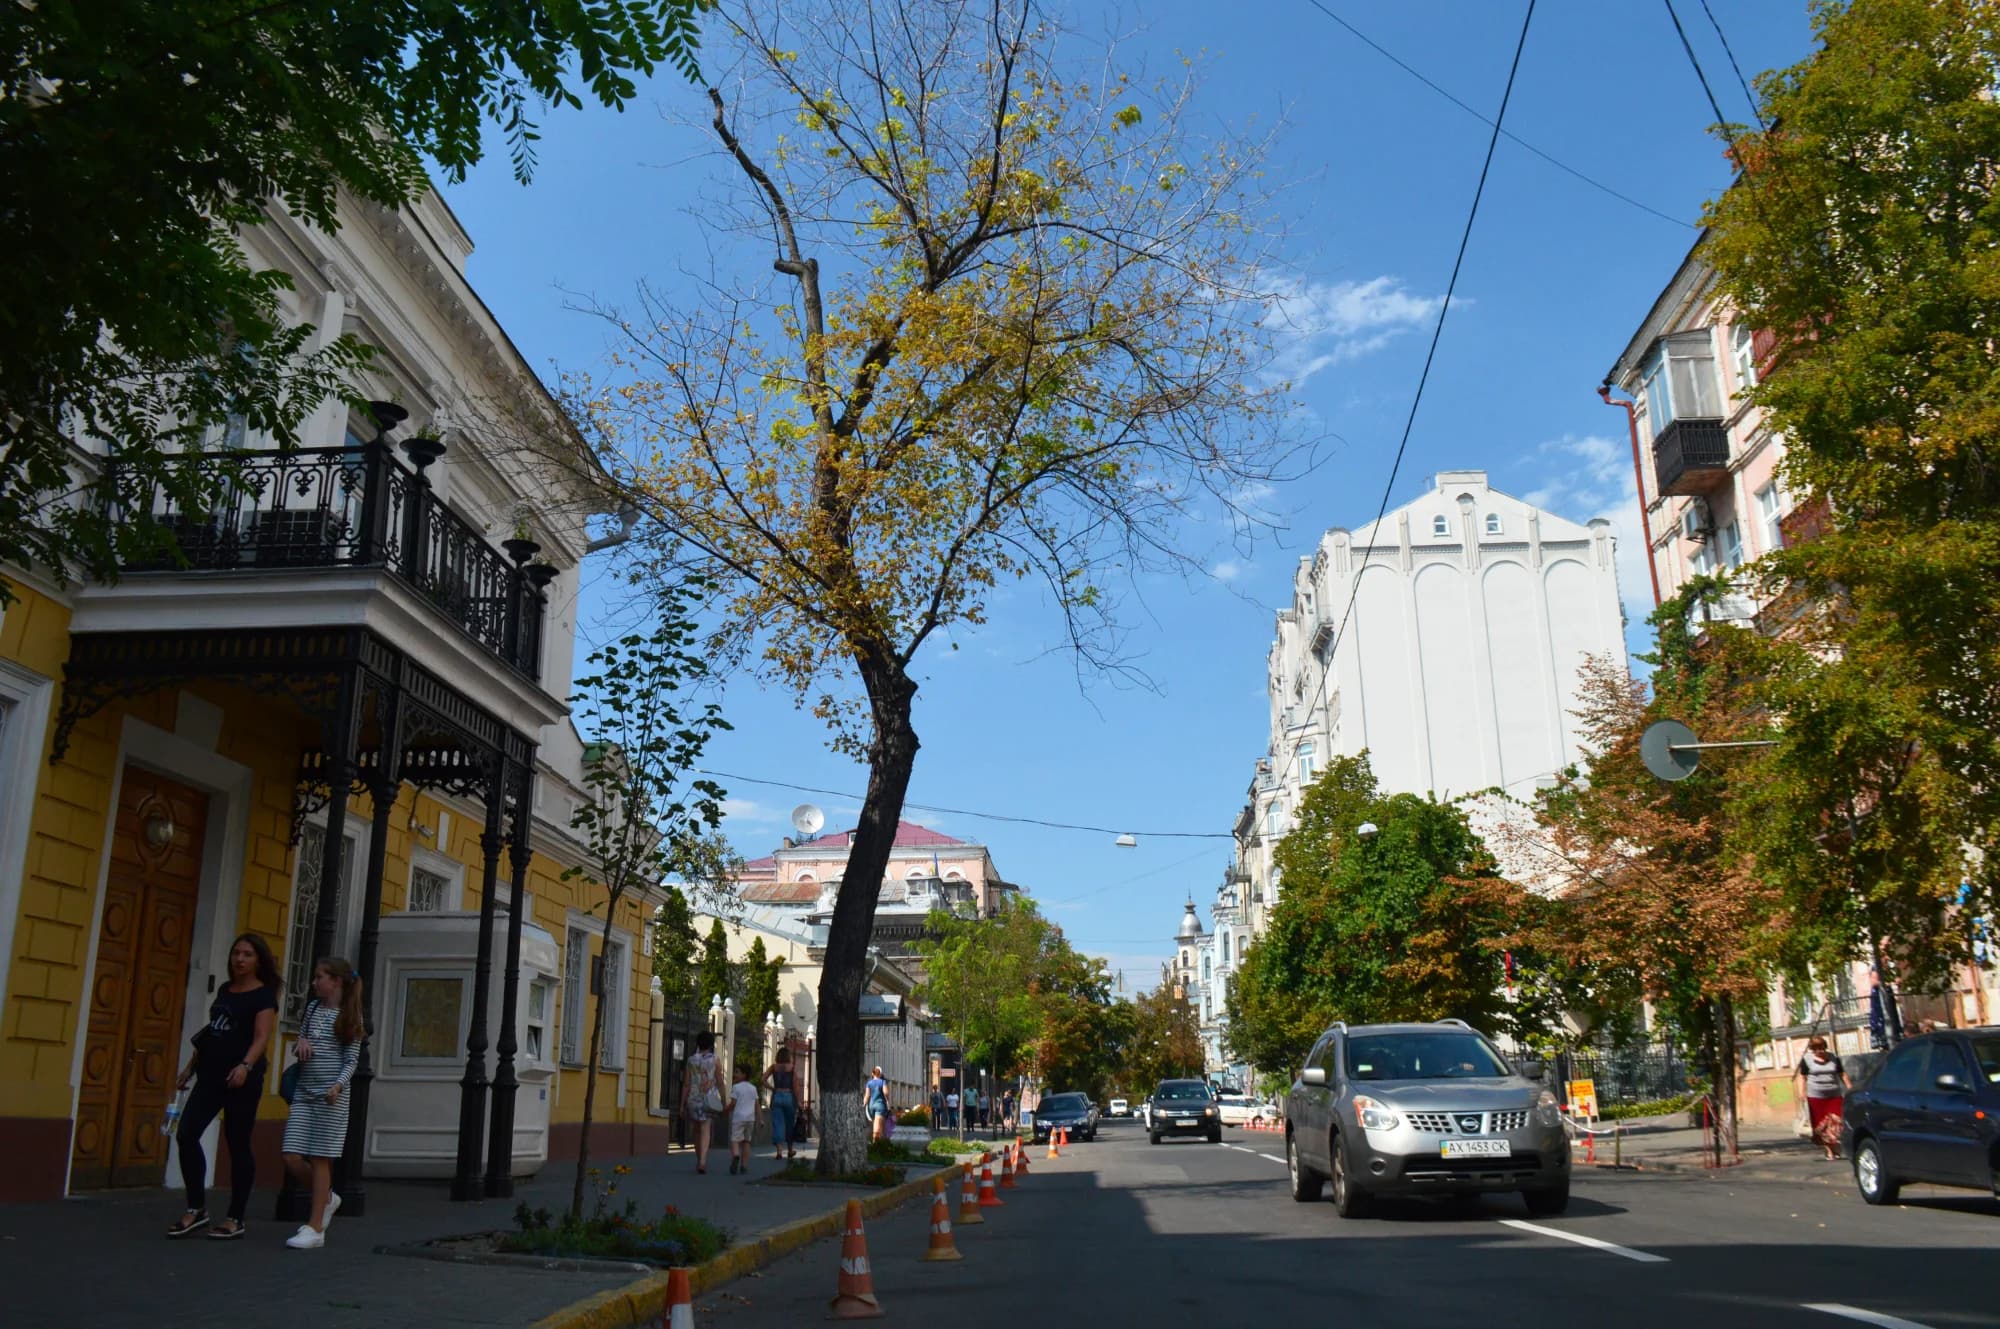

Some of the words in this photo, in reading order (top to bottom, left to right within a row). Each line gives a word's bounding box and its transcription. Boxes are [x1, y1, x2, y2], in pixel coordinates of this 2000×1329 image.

[1449, 1143, 1464, 1153] AX
[1466, 1141, 1489, 1153] 1453
[1492, 1142, 1507, 1152] CK
